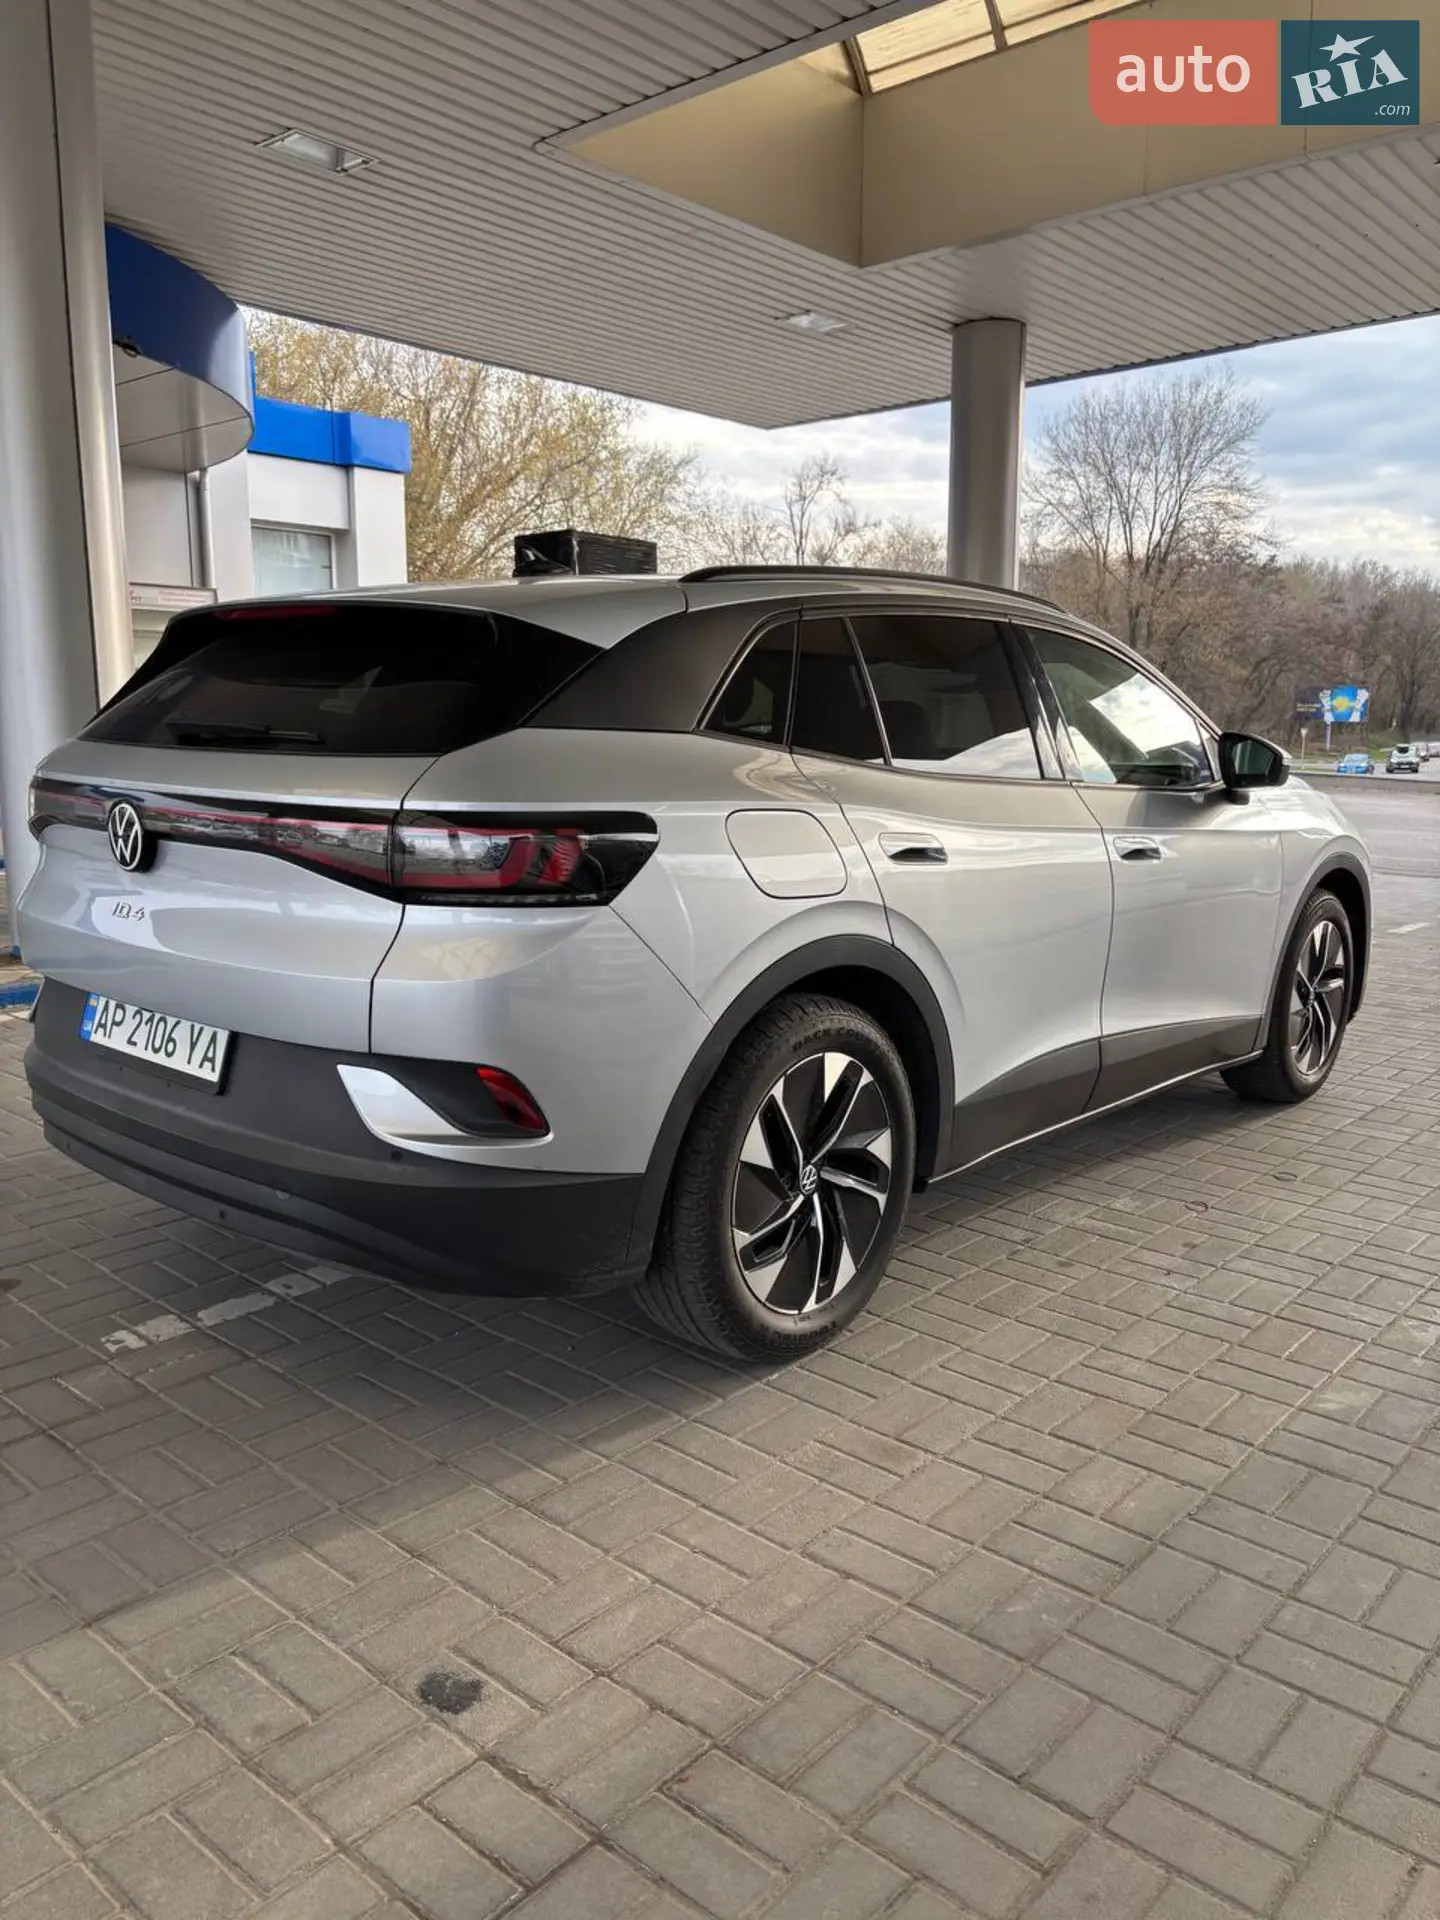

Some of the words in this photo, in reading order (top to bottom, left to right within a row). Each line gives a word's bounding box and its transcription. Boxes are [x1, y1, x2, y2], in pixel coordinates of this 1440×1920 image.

[94, 1000, 127, 1039] AP
[126, 1009, 182, 1058] 2106
[186, 1023, 219, 1073] YA
